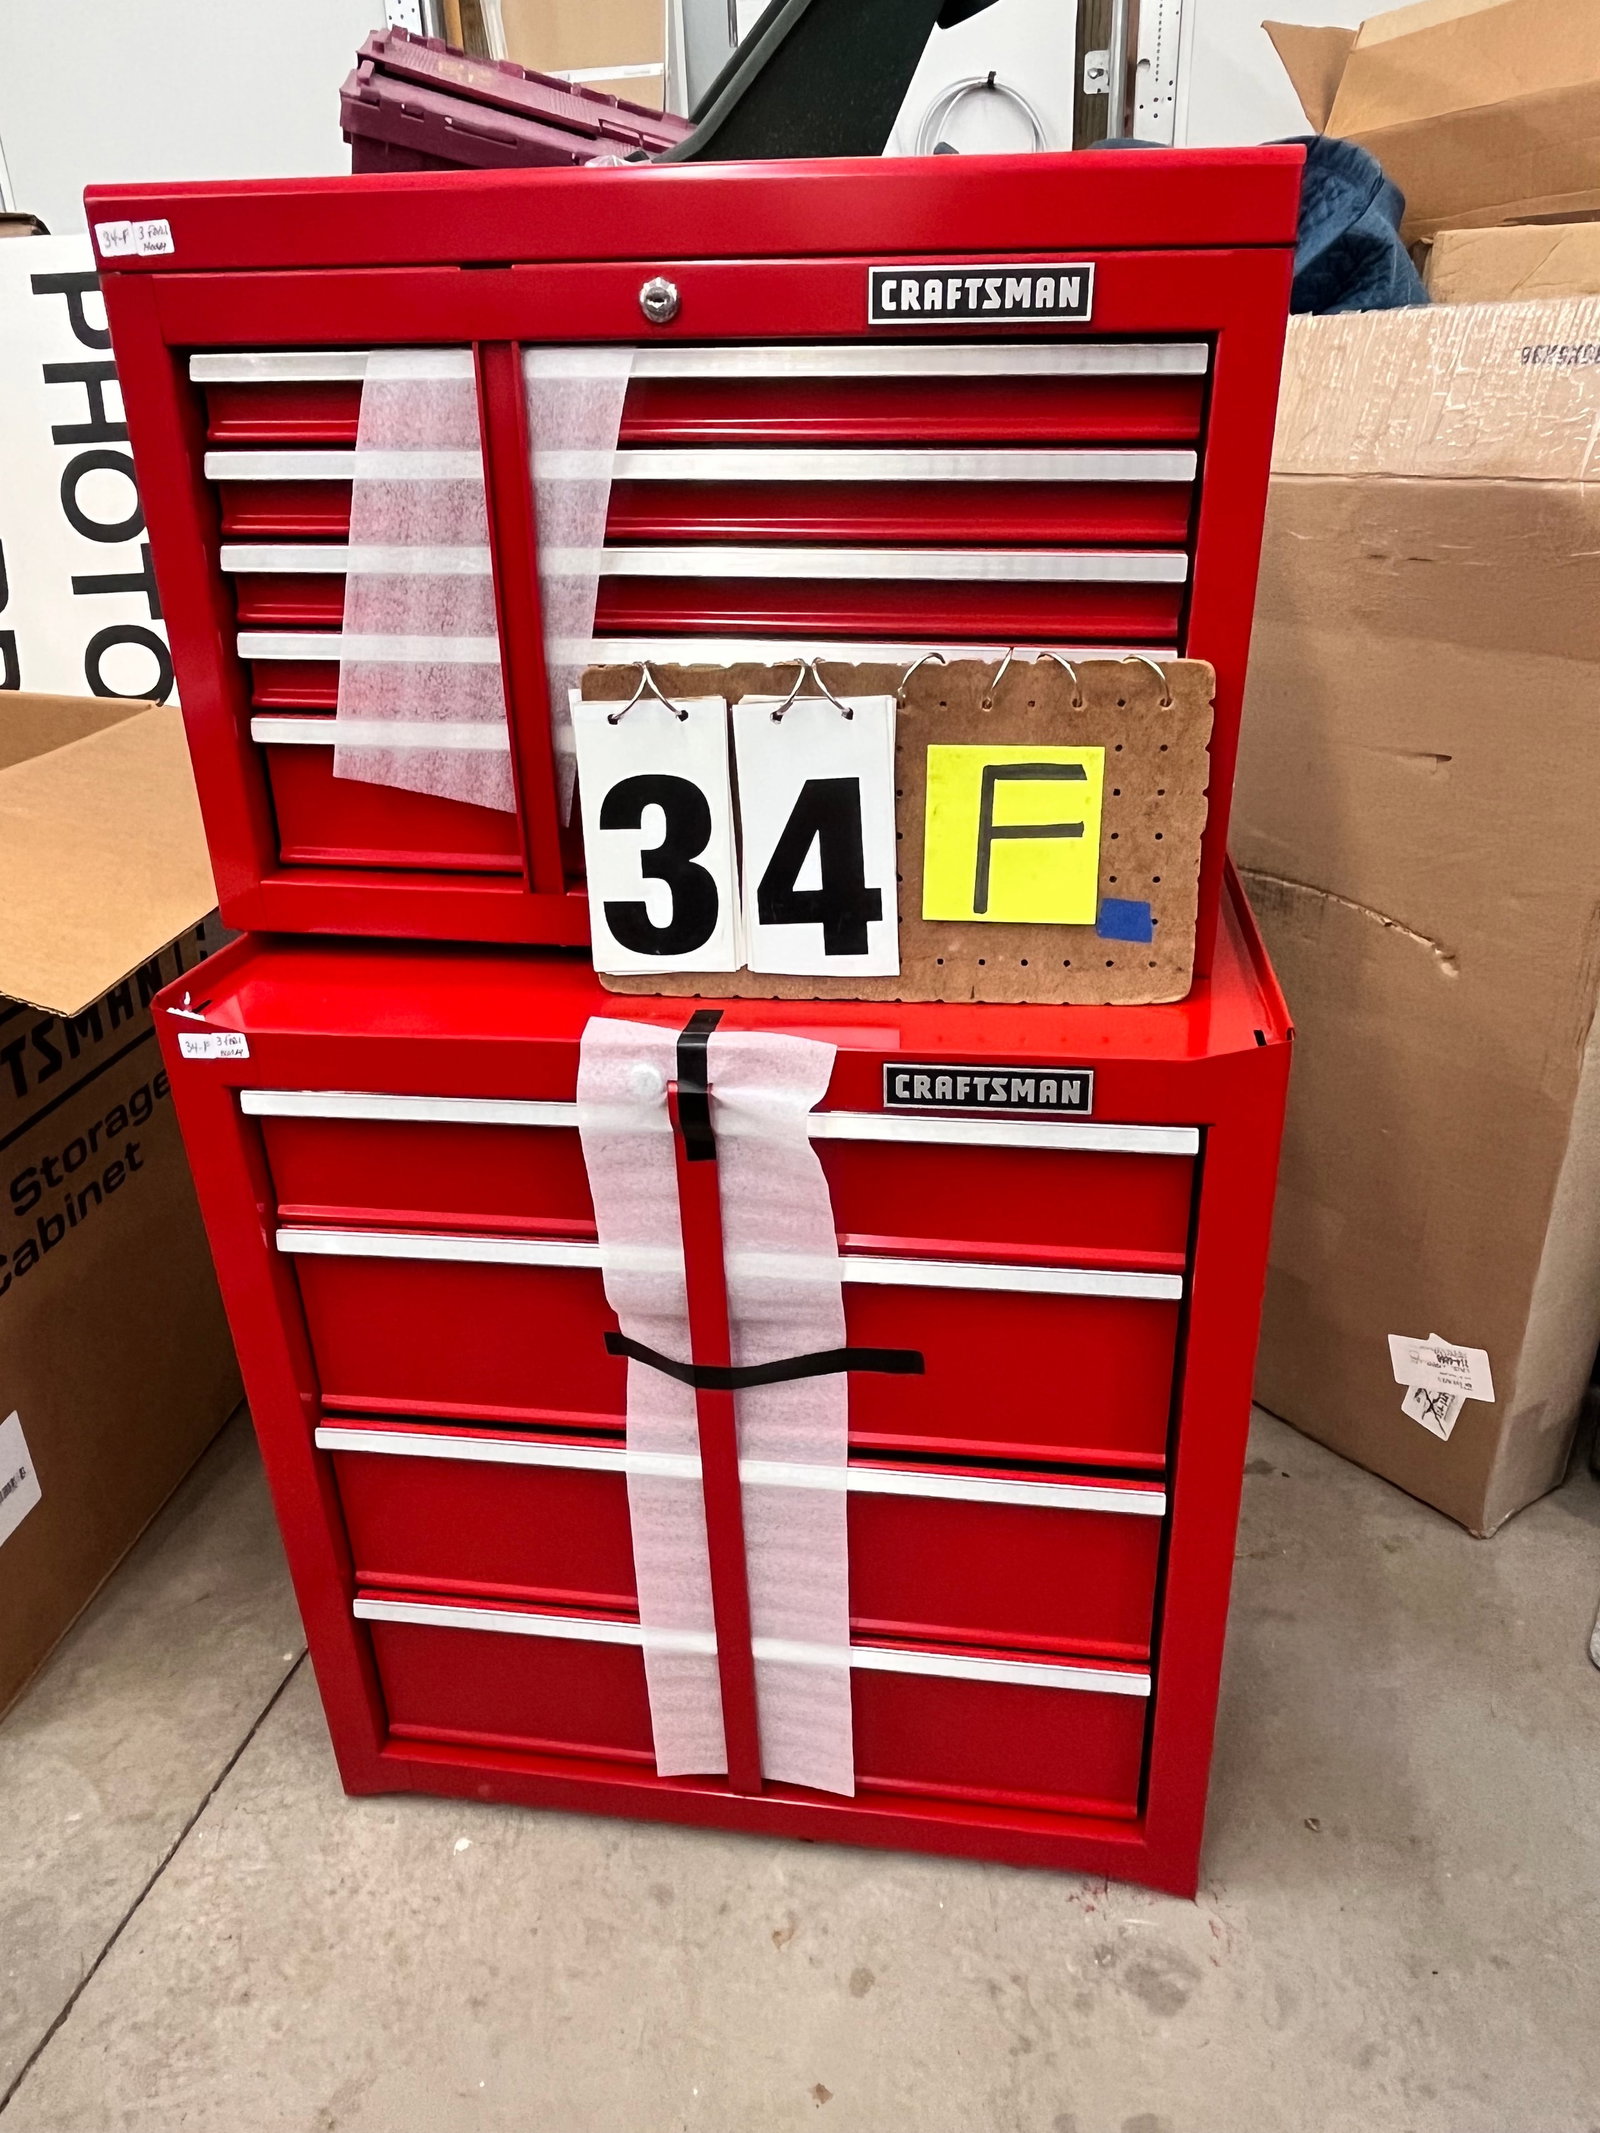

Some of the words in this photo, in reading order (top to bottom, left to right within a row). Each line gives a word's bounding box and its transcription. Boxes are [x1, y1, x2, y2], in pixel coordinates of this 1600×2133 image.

[881, 276, 1081, 311] CRAFTSMAN
[30, 271, 175, 705] PHOTO
[973, 763, 1088, 914] F
[10, 1069, 170, 1216] Storage
[895, 1074, 1081, 1104] CRAFTSMAN
